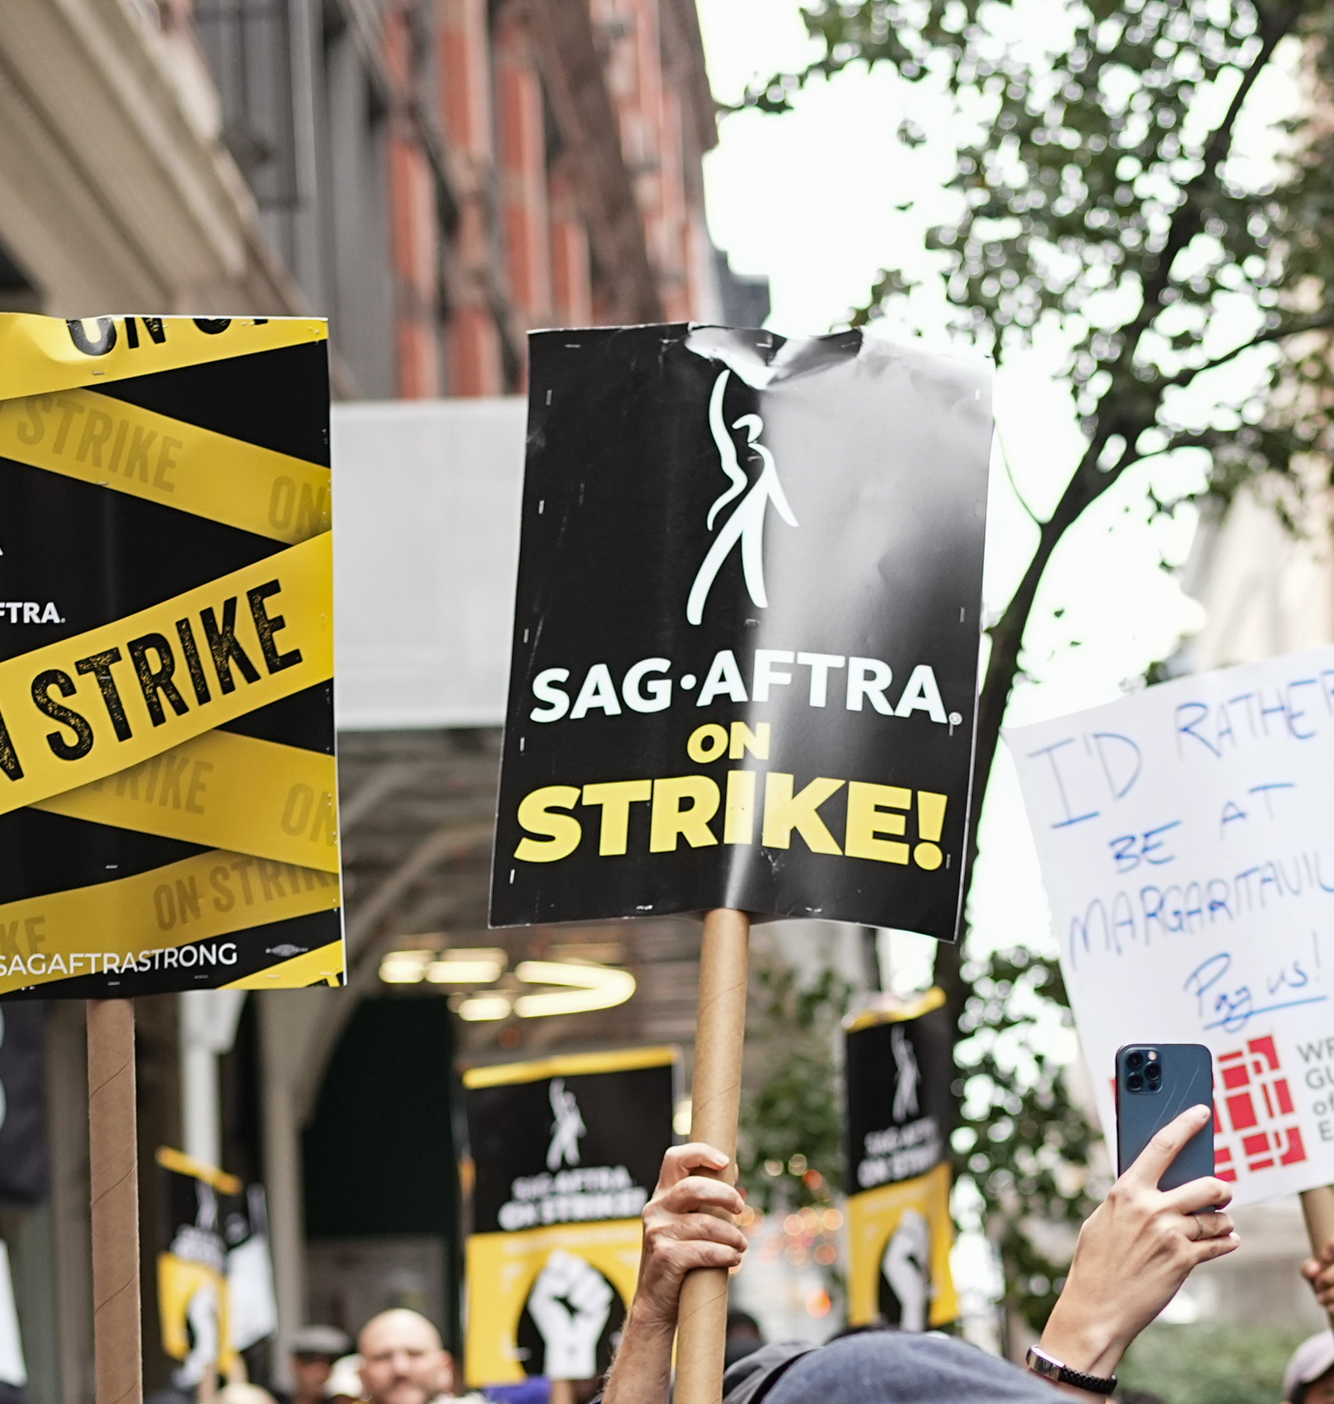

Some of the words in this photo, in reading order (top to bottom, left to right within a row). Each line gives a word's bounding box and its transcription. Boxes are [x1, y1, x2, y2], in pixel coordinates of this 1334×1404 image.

[17, 394, 183, 494] STRIKE
[30, 578, 303, 761] STRIKE
[686, 721, 772, 764] ON
[1026, 731, 1143, 829] I'D
[513, 769, 949, 872] STRIKE!
[1108, 819, 1182, 875] BE
[1219, 781, 1296, 842] AT
[153, 880, 202, 932] ON
[1182, 951, 1254, 1034] Pay
